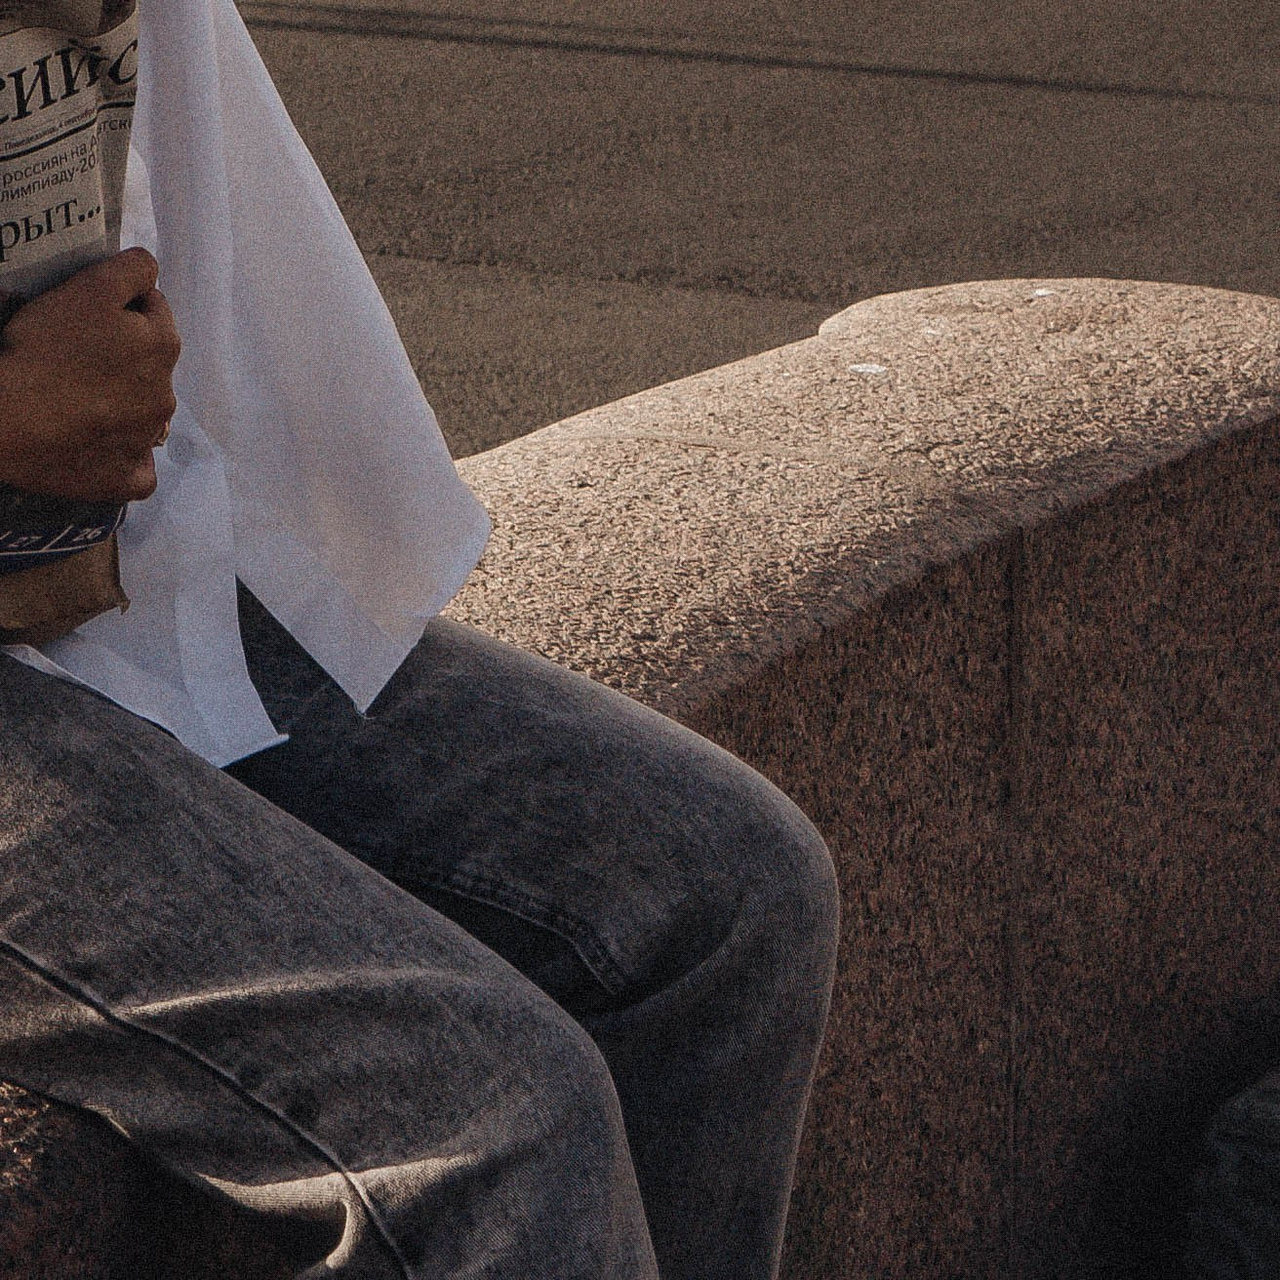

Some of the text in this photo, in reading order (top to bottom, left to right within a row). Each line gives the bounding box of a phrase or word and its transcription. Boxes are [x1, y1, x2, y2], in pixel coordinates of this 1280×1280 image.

[2, 153, 68, 189] россиян
[70, 144, 88, 159] на
[72, 525, 106, 542] 26
